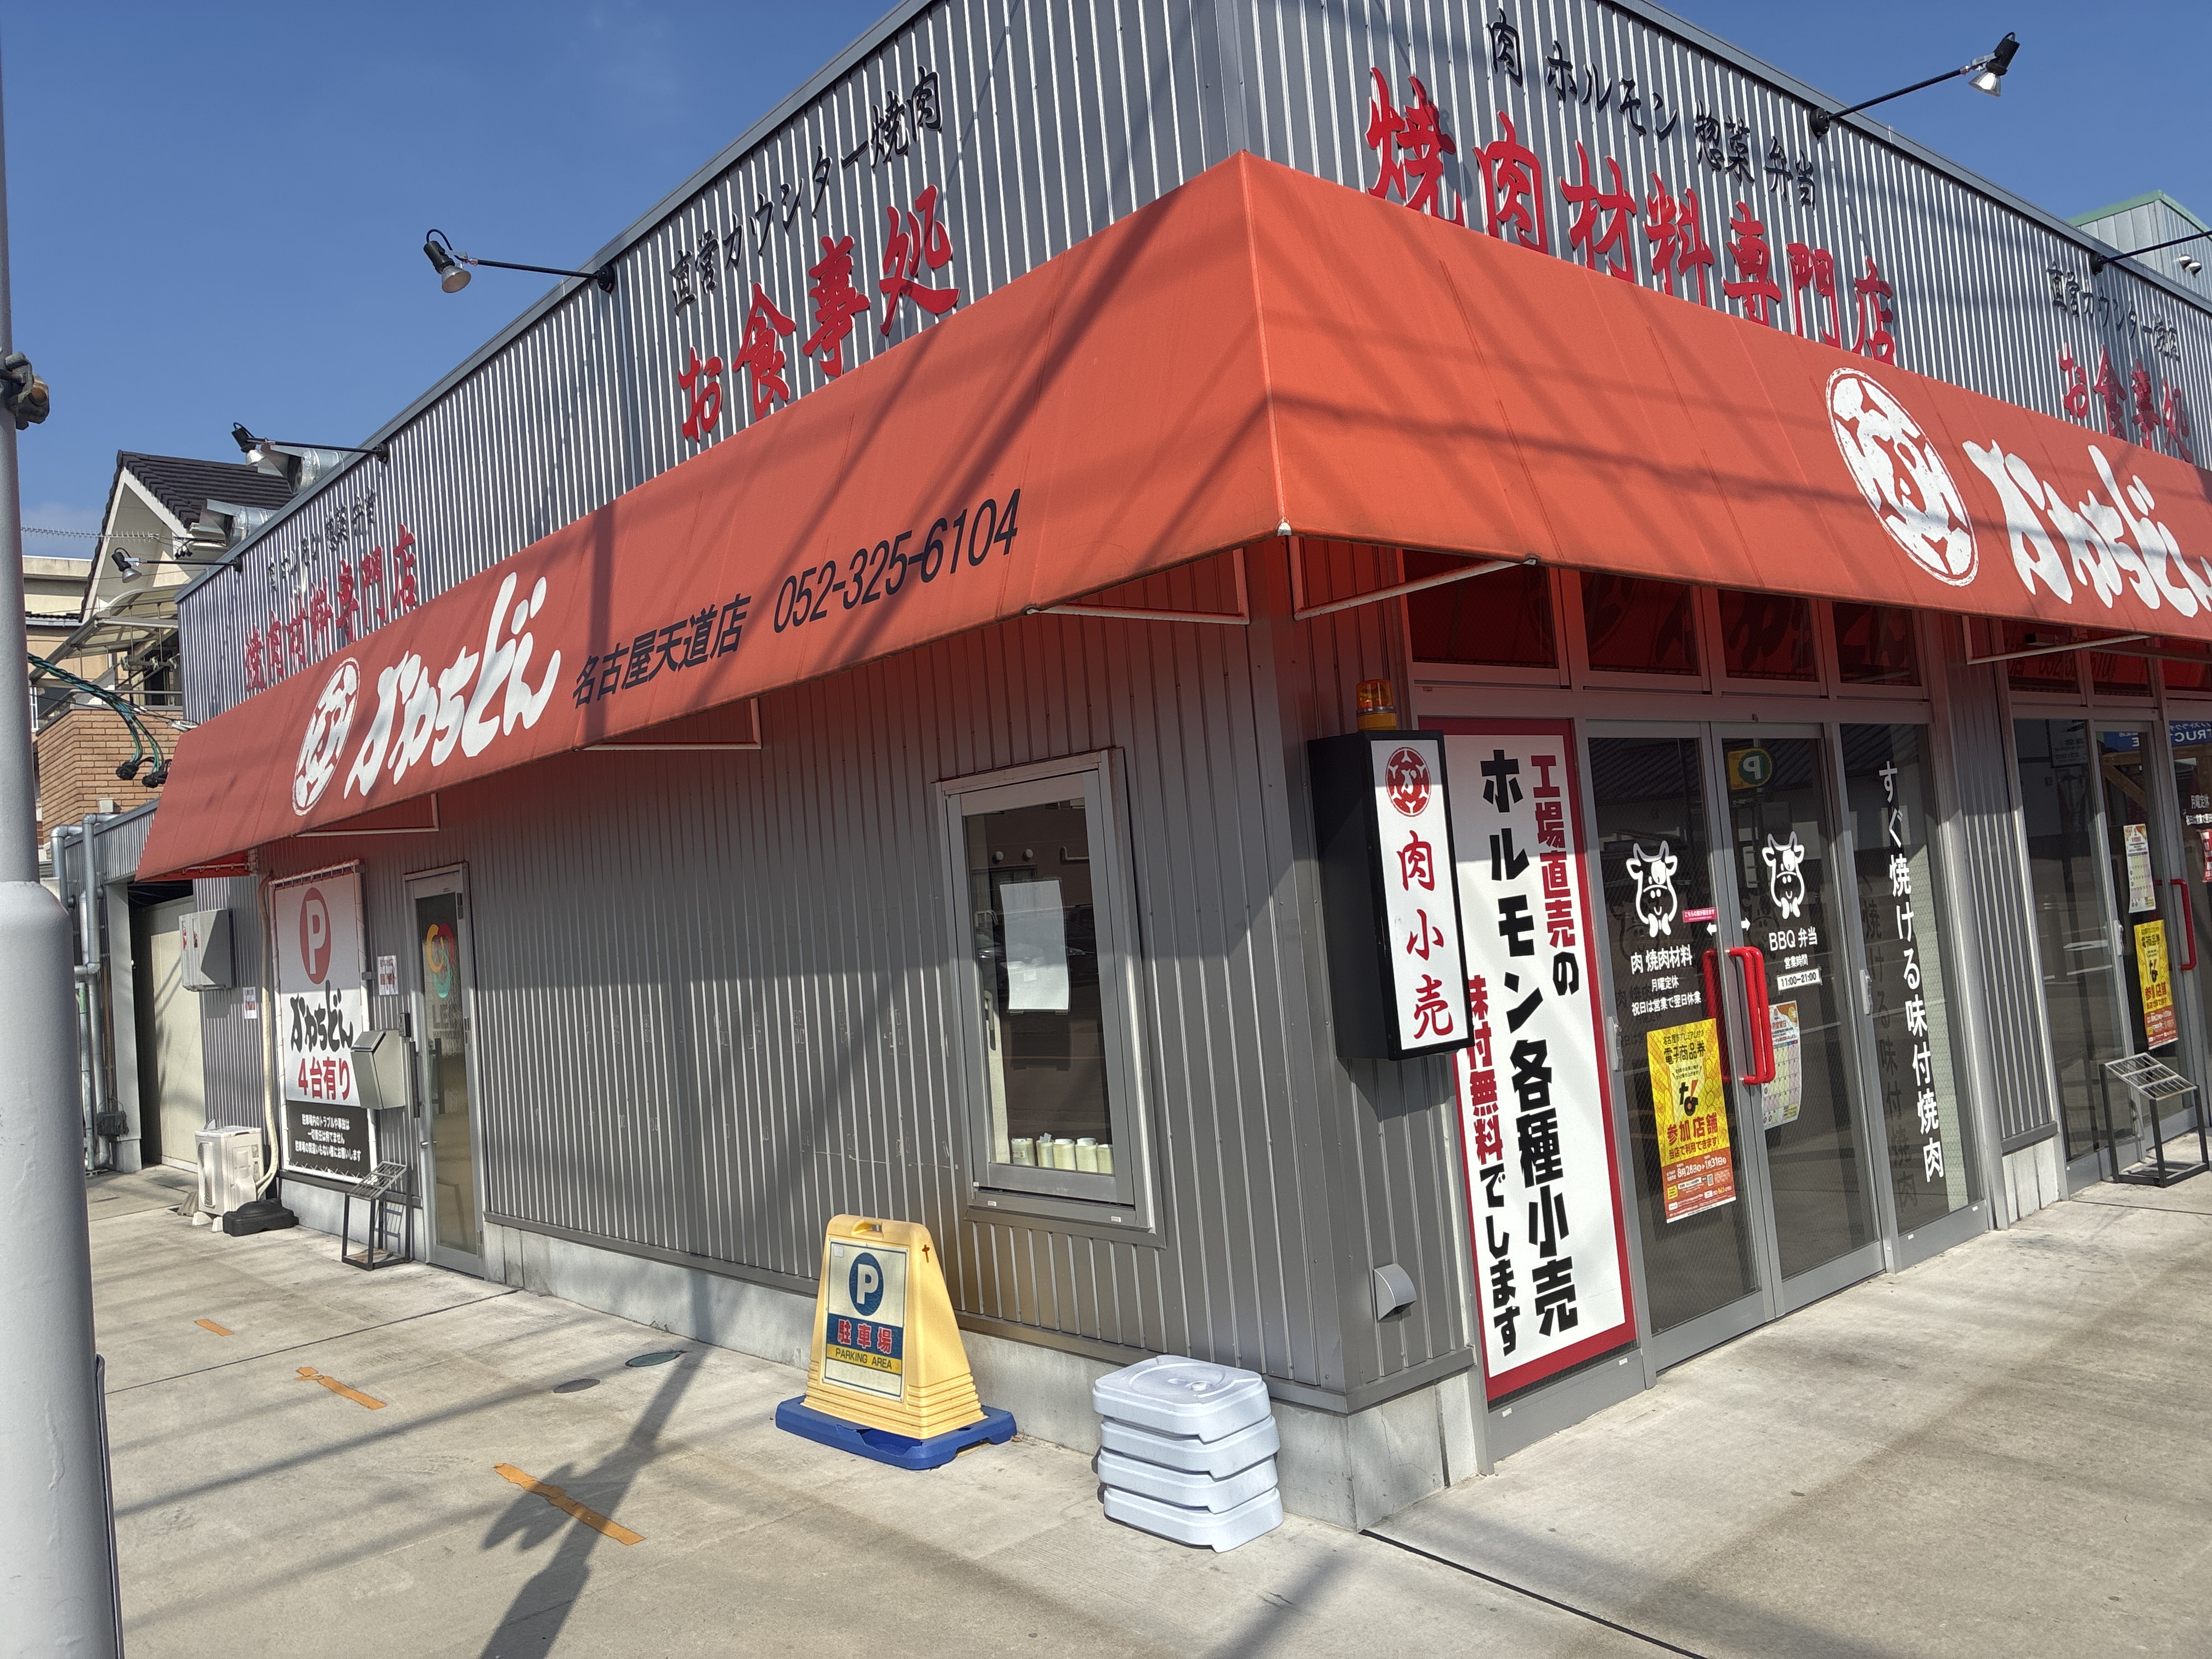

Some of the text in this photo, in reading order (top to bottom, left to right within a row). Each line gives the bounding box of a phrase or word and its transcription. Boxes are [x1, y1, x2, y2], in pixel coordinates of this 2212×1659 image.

[1487, 7, 1815, 210] 肉 ホルモン 惣菜 弁当
[669, 66, 942, 315] 直営カウンター焼肉
[1365, 67, 1895, 366] 焼肉材料専門店
[678, 184, 960, 441] お食事処
[2058, 342, 2194, 464] お食事処
[774, 488, 1022, 634] 052-325-6104
[573, 593, 752, 710] 名古屋天道店
[1531, 754, 1579, 996] 工場直売の
[306, 899, 327, 974] P
[1396, 829, 1454, 1040] 肉小売
[1630, 944, 1692, 975] 肉 焼肉材料
[1769, 926, 1818, 951] BBQ 弁当
[1784, 954, 1809, 969] 営業時間
[1878, 760, 1944, 1183] すぐ焼ける味付焼肉
[1632, 991, 1701, 1016] 祝日は営業で翌日休業
[1651, 974, 1679, 992] 月曜定休
[298, 1056, 350, 1101] 4台有り
[1480, 749, 1578, 1337] ホルモン各種小売
[1664, 1040, 1706, 1065] 電子商品券
[1667, 1111, 1718, 1147] 参加店舗
[856, 1263, 879, 1305] P
[836, 1348, 893, 1370] PARKING AREA
[837, 1318, 893, 1355] 駐車場
